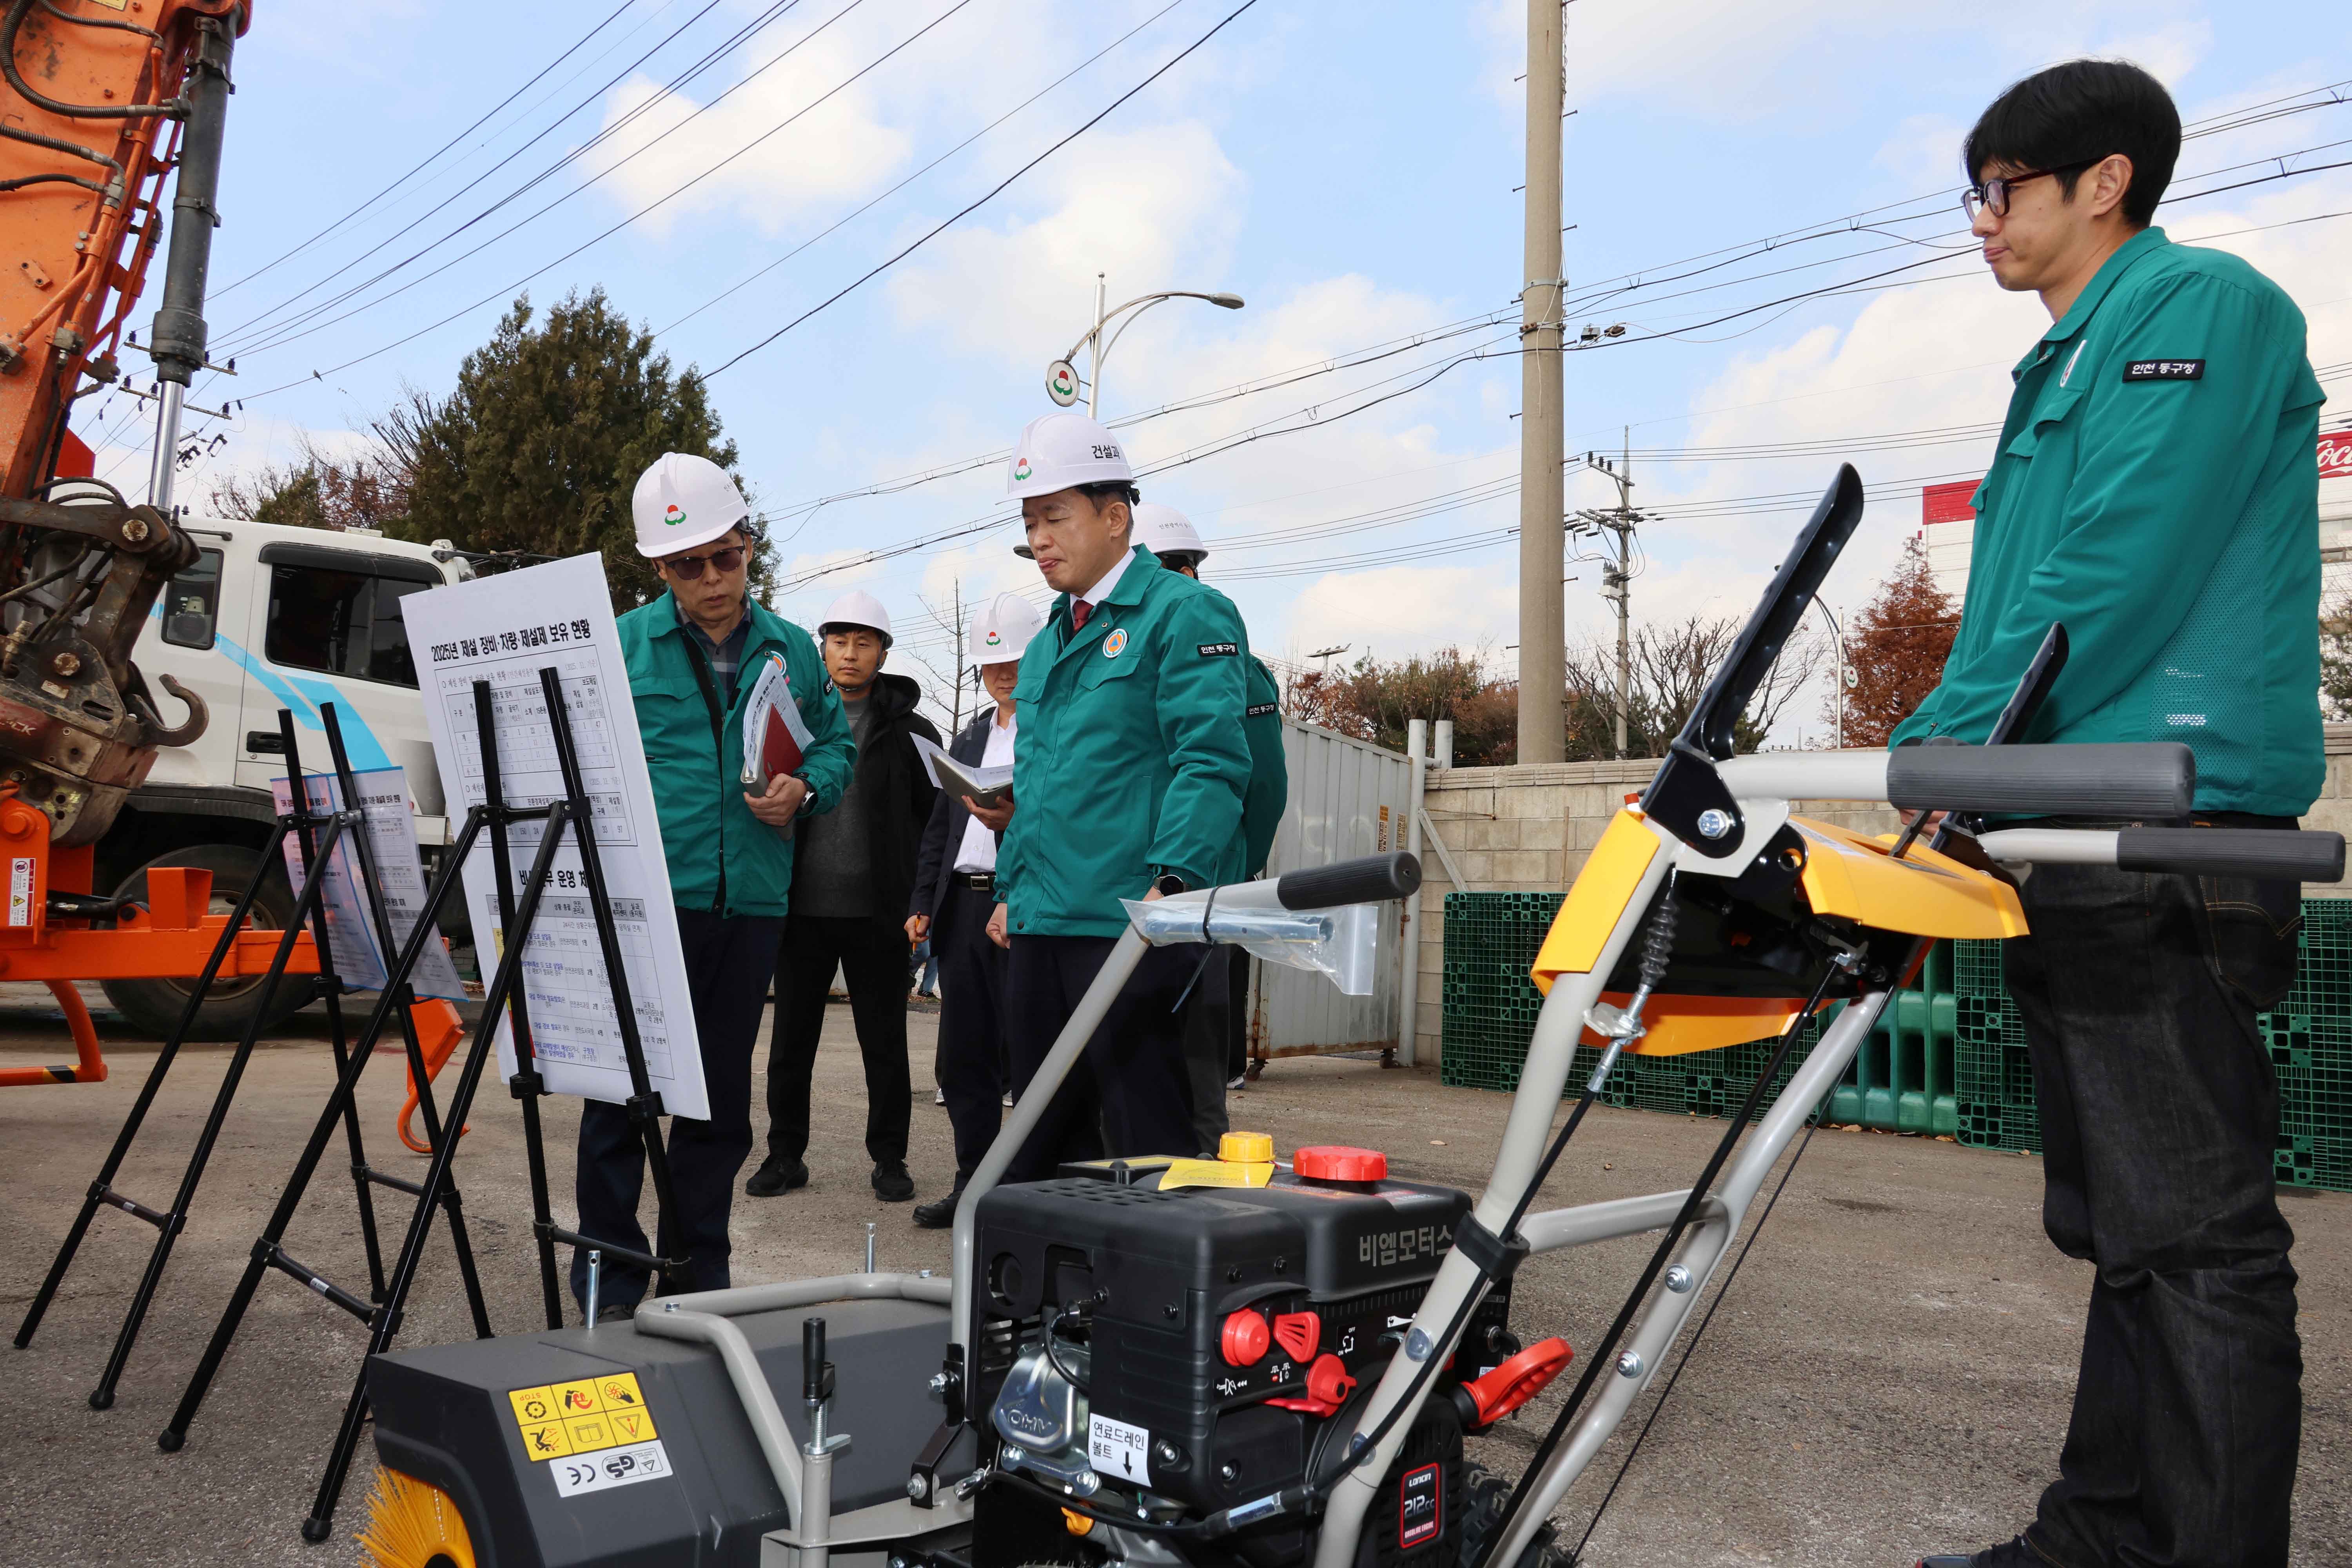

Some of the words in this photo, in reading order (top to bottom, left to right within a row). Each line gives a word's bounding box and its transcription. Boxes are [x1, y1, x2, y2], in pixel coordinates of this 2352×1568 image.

[2132, 363, 2155, 375] 인천
[2158, 363, 2196, 374] 동구청
[1091, 445, 1120, 460] 건설과
[431, 642, 459, 662] 2025년
[460, 638, 478, 658] 제설
[549, 622, 570, 643] 보유
[570, 618, 591, 640] 현황
[1201, 645, 1215, 654] 인천
[1216, 644, 1236, 653] 동구청
[1260, 704, 1274, 713] 동구청
[519, 870, 555, 887] 비무
[556, 870, 576, 888] 운영
[1359, 1225, 1454, 1268] 비엠모터스
[520, 1392, 541, 1401] STOP
[1008, 1410, 1051, 1434] OHV
[1094, 1421, 1145, 1451] 연료드레인
[1093, 1441, 1113, 1460] 볼트
[1409, 1472, 1432, 1488] LONCIN
